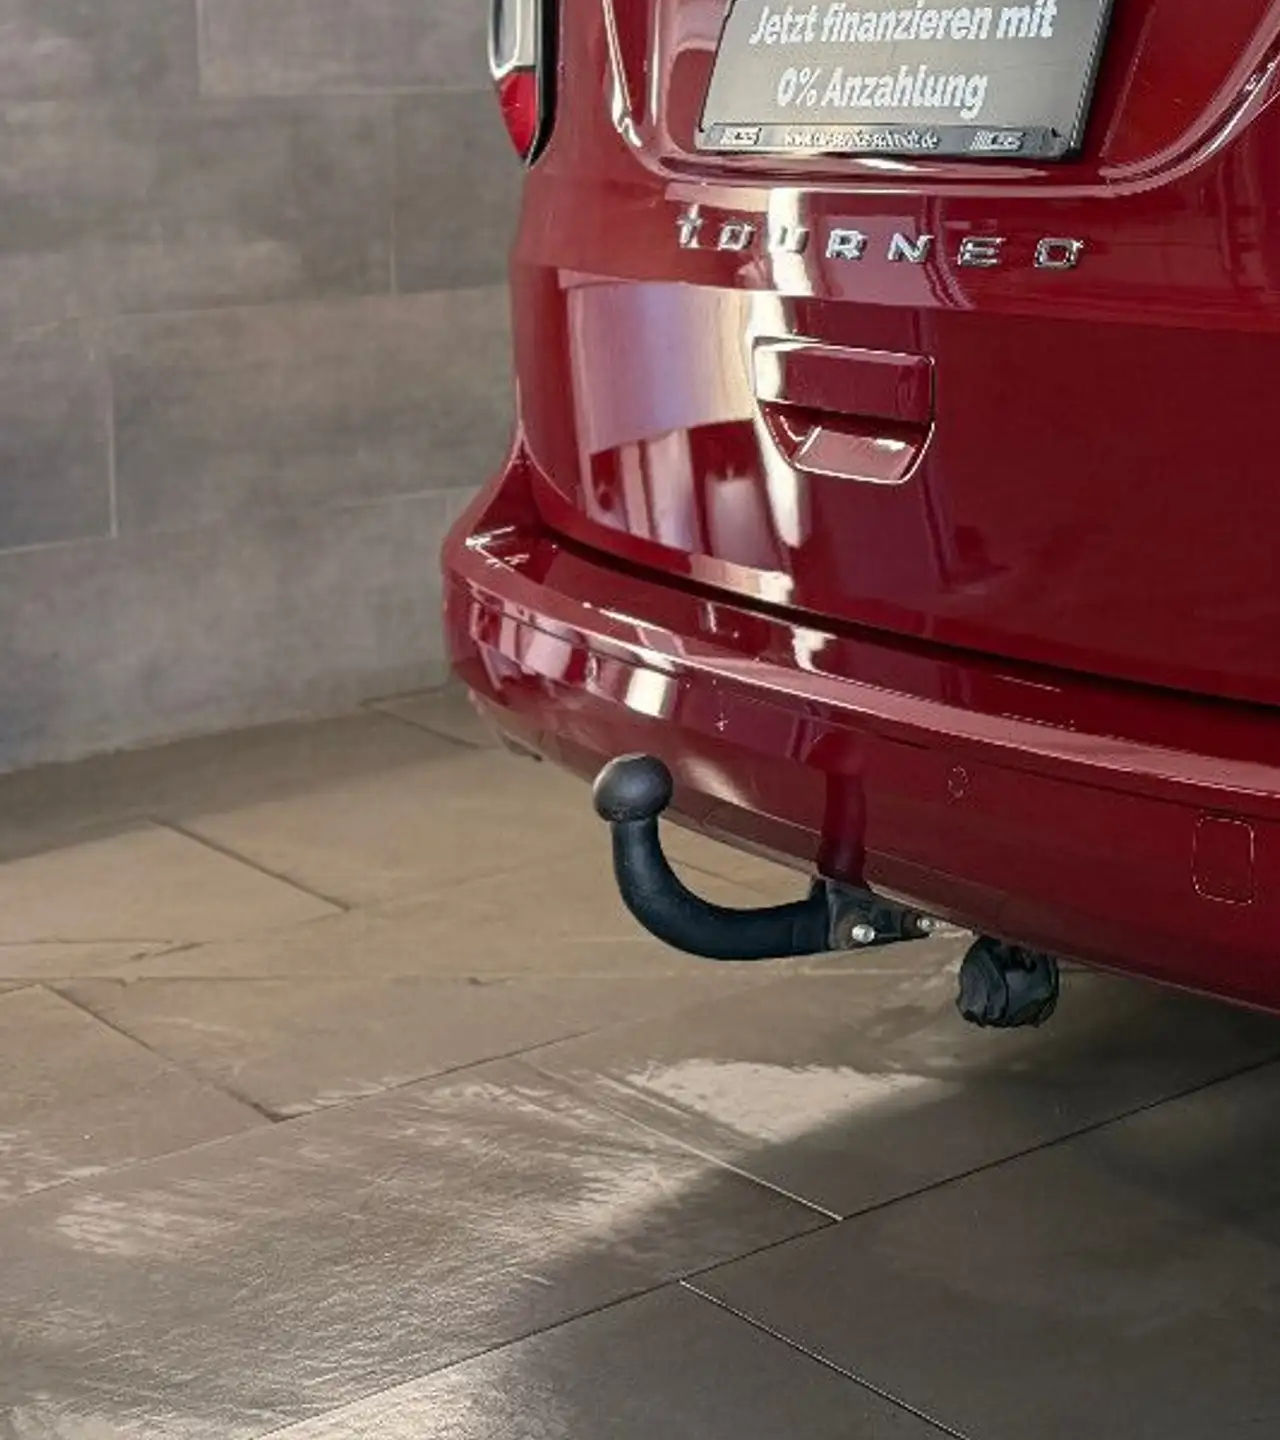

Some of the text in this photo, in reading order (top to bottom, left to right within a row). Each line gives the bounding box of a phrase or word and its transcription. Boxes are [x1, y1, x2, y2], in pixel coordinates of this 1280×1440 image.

[749, 5, 819, 45] Jetzt
[820, 3, 993, 43] finanzieren
[777, 64, 988, 120] 0% Anzahlung
[676, 202, 1085, 268] TOURNEO
